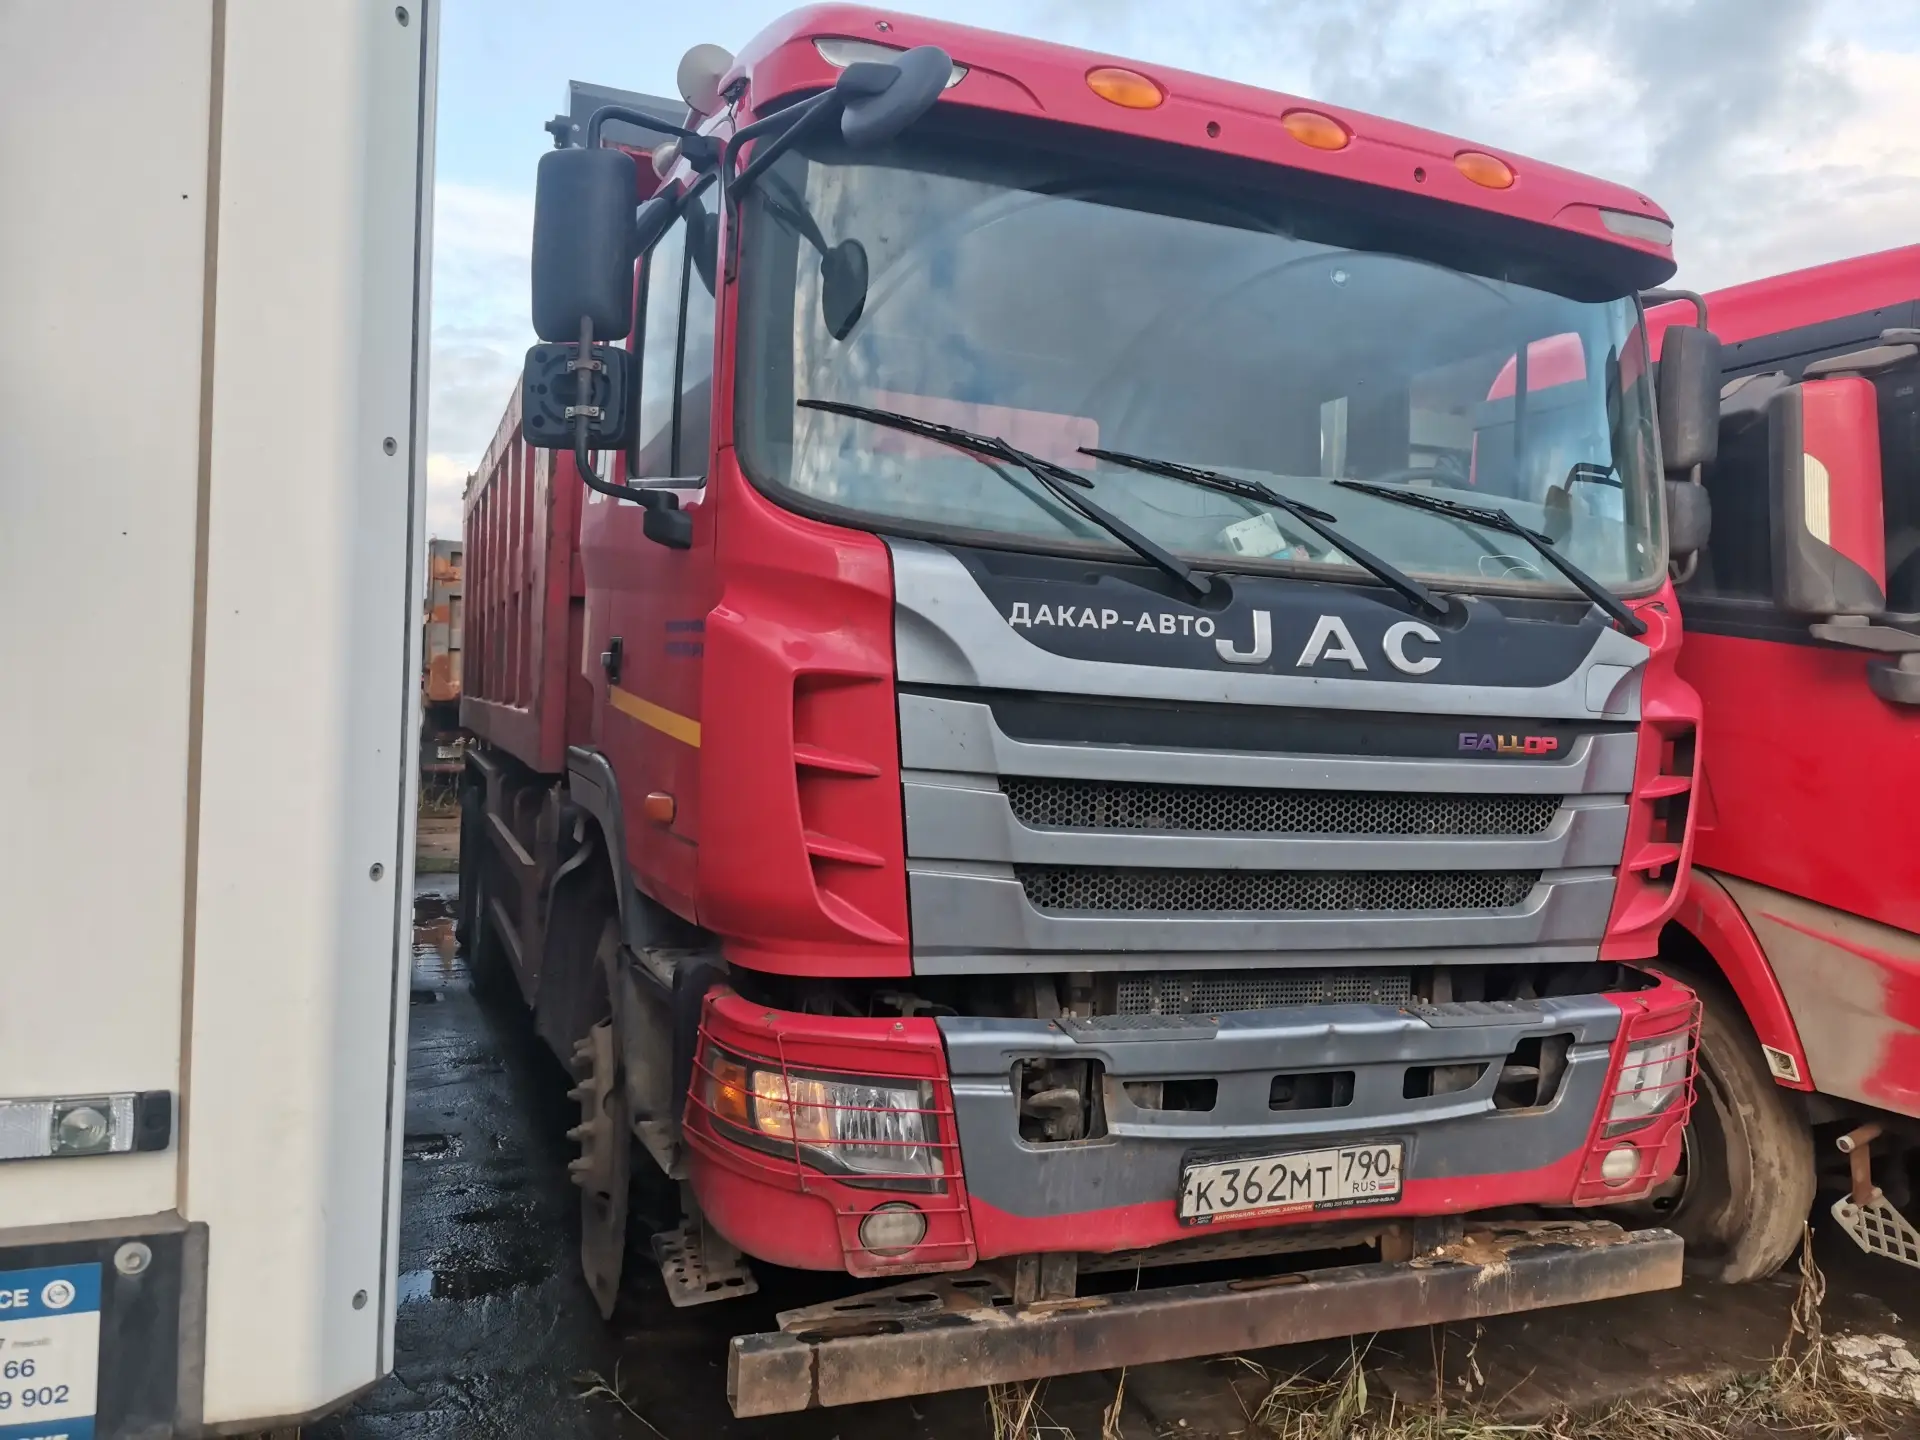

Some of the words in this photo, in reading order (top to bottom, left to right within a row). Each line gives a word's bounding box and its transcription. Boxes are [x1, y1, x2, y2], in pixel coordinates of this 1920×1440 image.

[1009, 602, 1215, 637] ДАКАР-АВТО
[1216, 609, 1442, 676] JAC
[1458, 732, 1558, 755] GALLOP
[1342, 1149, 1391, 1182] 790
[1352, 1180, 1377, 1194] RUS
[4, 1359, 35, 1379] 66
[22, 1385, 69, 1408] 902
